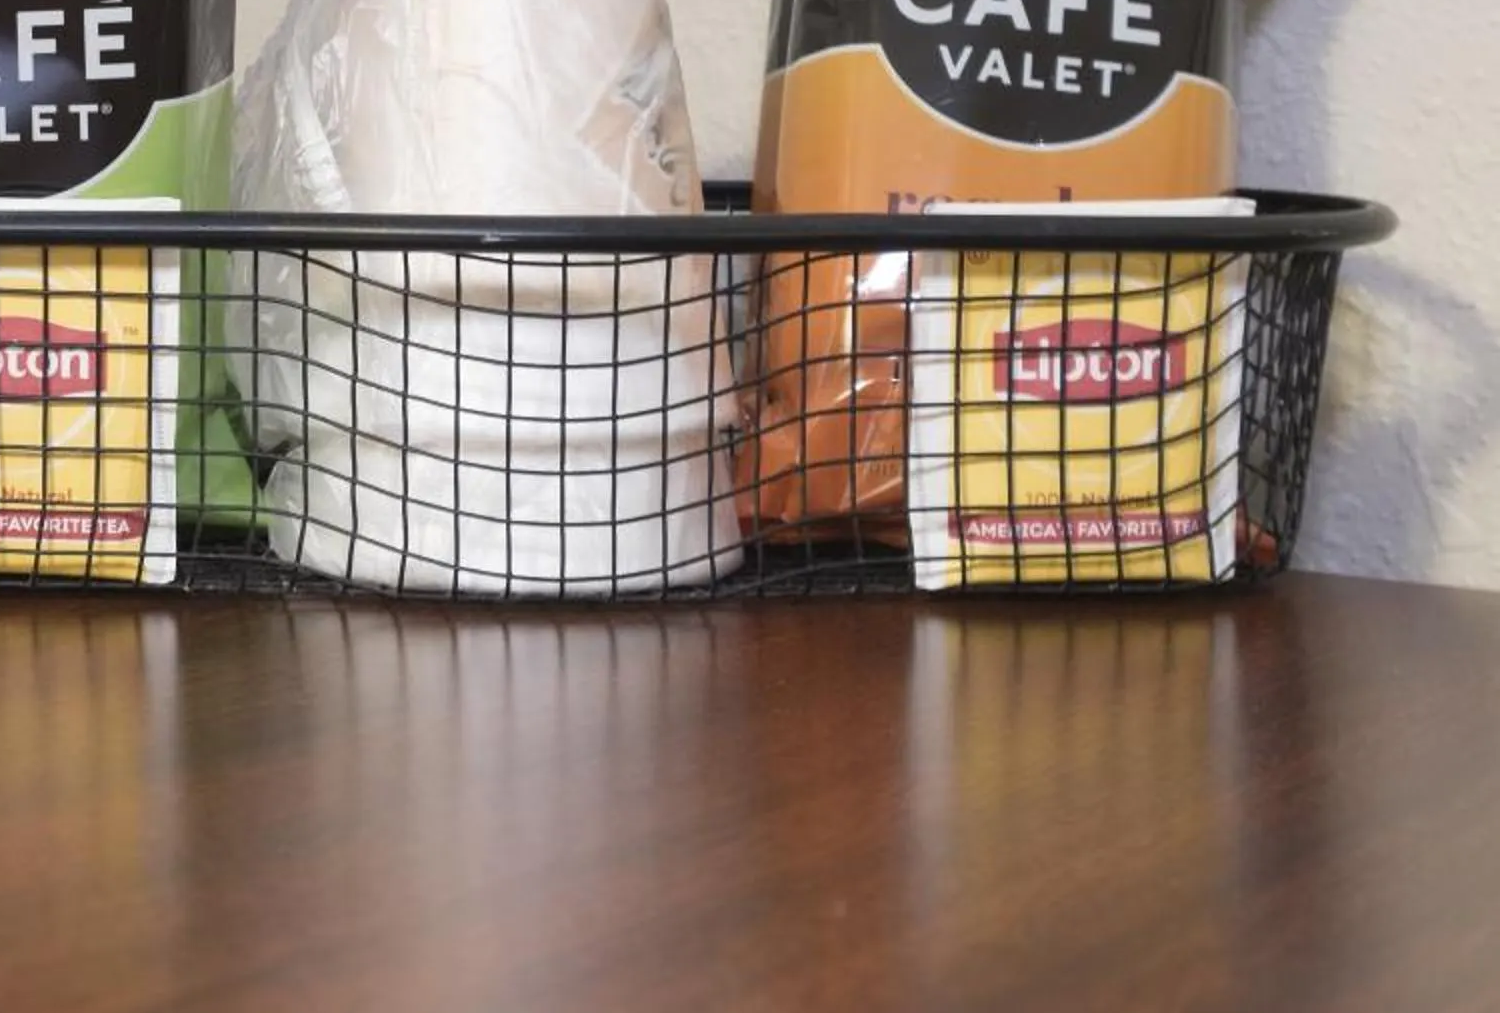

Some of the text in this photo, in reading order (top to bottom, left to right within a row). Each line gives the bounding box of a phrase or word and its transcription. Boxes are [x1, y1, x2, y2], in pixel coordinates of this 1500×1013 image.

[938, 43, 1124, 98] VALET
[1010, 336, 1172, 391] Lipton
[0, 516, 92, 534] FAVORITE
[97, 518, 131, 534] TEA
